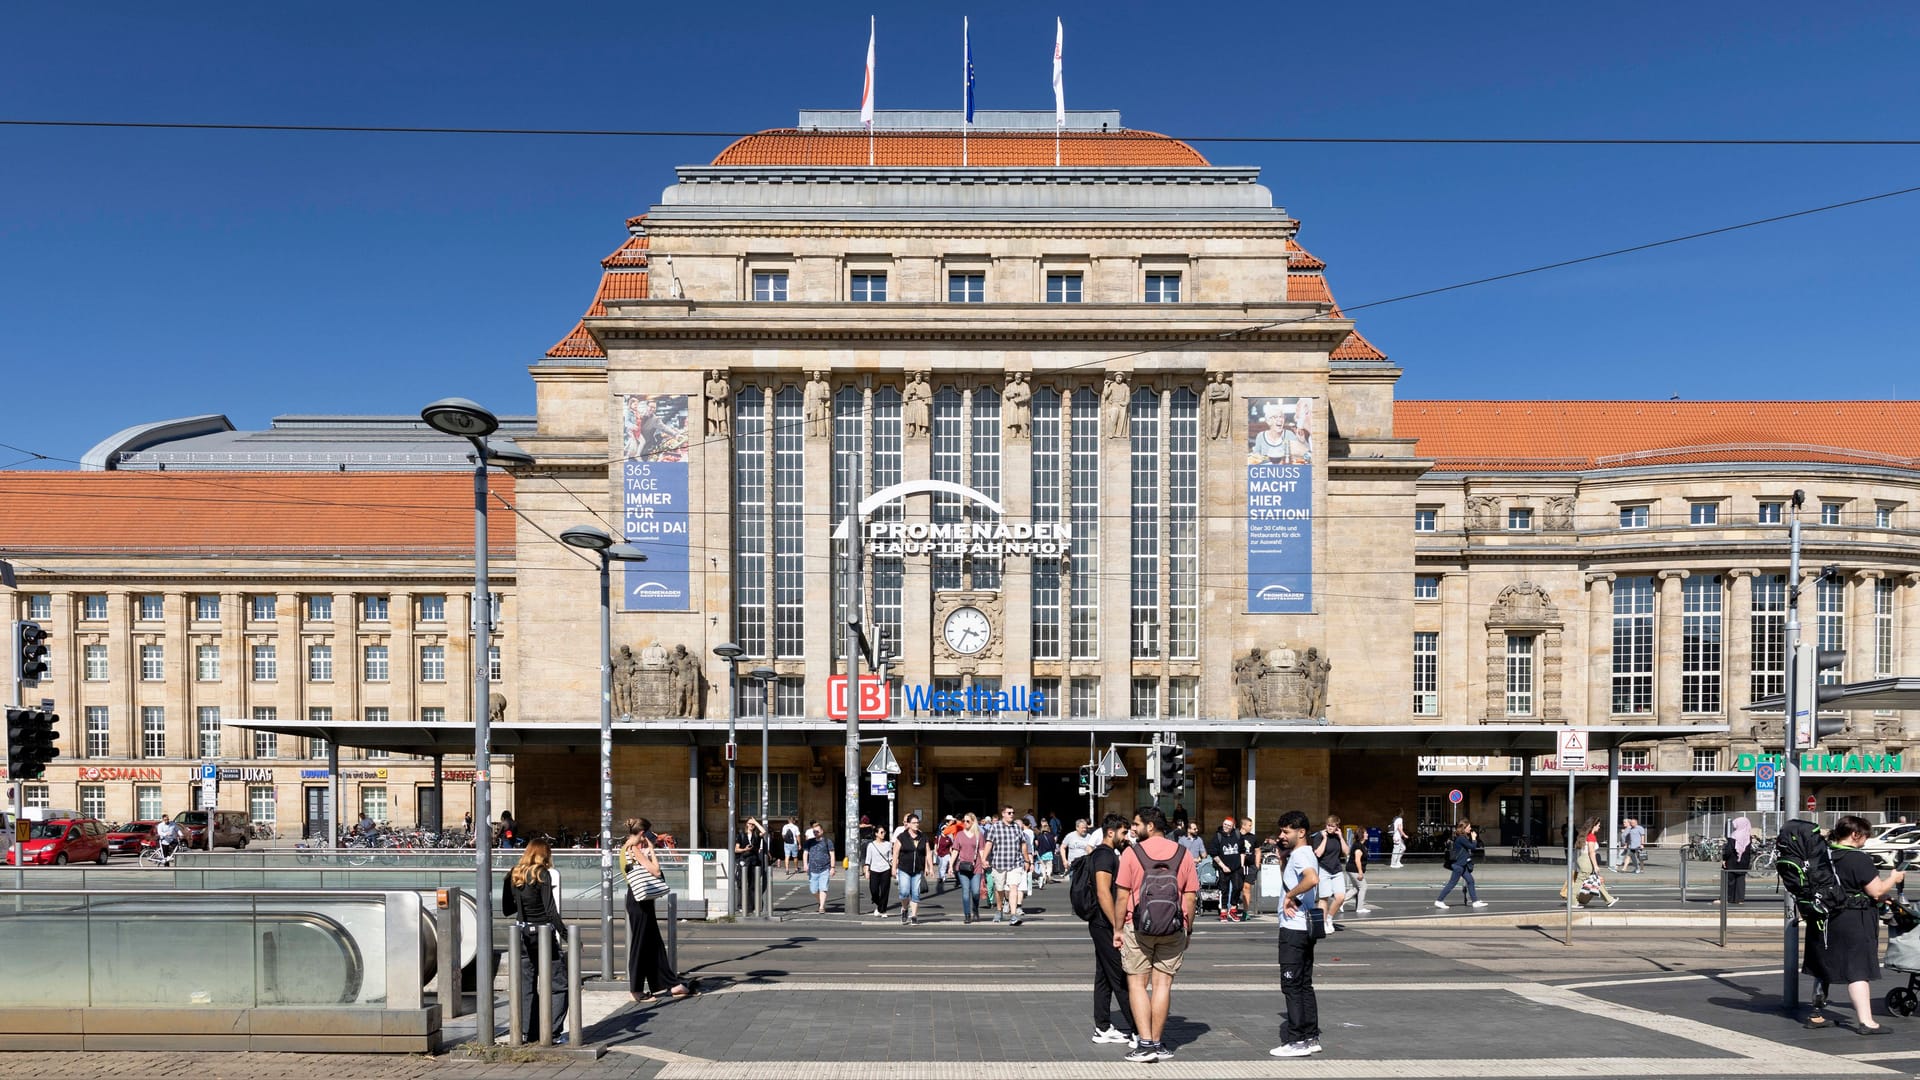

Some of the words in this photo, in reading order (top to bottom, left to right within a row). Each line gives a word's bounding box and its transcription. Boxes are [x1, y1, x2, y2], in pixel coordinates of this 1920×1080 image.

[626, 464, 651, 476] 365
[1250, 466, 1300, 479] GENUSS
[626, 478, 658, 490] TAGE
[1250, 481, 1298, 493] MACHT
[626, 493, 672, 505] IMMER
[1250, 495, 1282, 506] HIER
[626, 504, 655, 519] FÜR
[1250, 508, 1310, 521] STATION!
[626, 521, 660, 534] DICH
[663, 521, 687, 534] DA!
[870, 522, 1073, 540] PROMENADEN
[870, 542, 1073, 554] HAUPTBAHNHOF
[905, 684, 1045, 712] Westhalle
[78, 767, 162, 780] ROSSMANN
[204, 766, 213, 777] P
[240, 767, 272, 781] LUKAS
